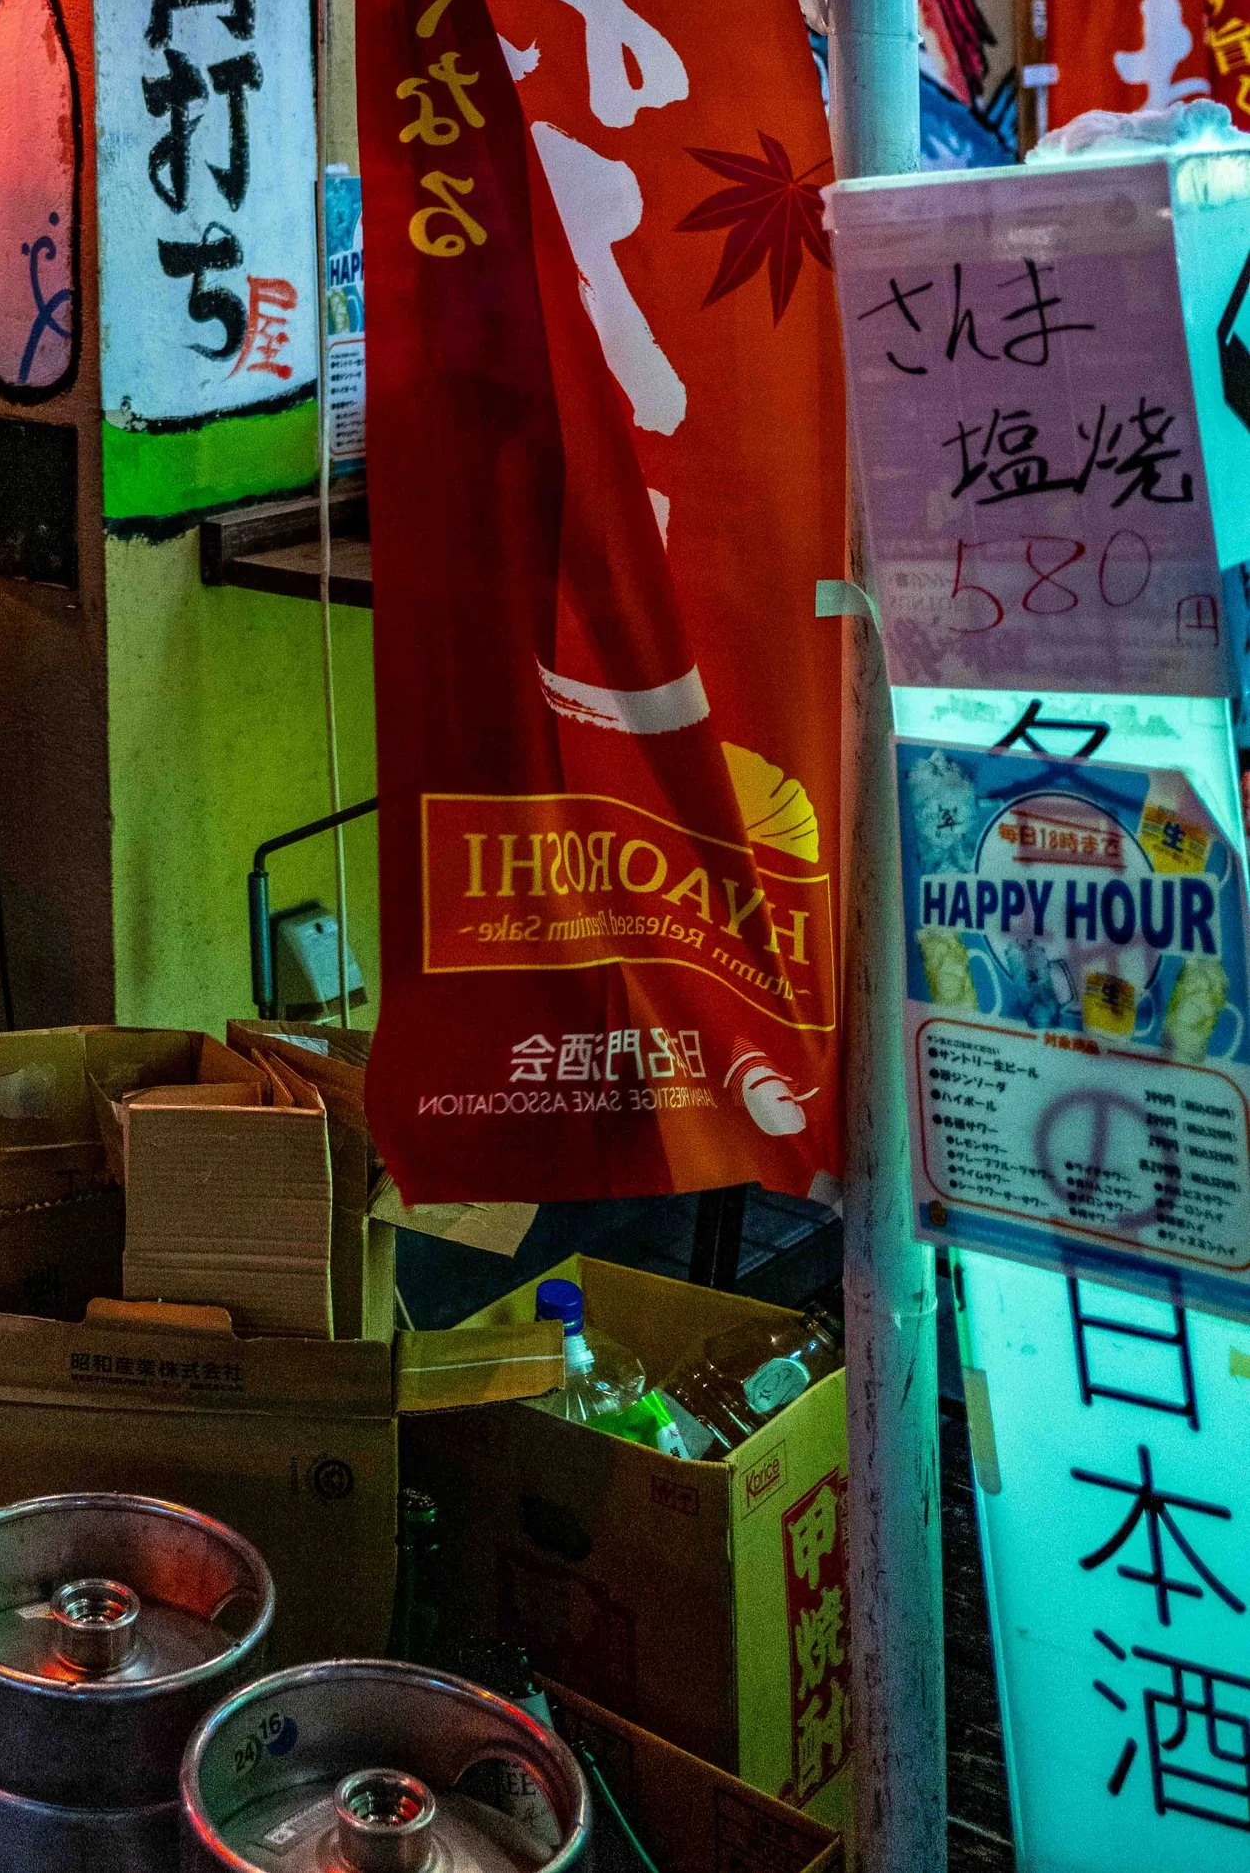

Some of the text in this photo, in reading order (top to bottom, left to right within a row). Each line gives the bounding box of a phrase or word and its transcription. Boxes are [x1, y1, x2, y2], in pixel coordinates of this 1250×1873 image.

[330, 250, 364, 287] HAP
[857, 259, 1095, 374] さんま
[942, 397, 1193, 507] 塩焼
[923, 878, 1218, 954] HAPPY HOUR
[70, 1352, 244, 1381] 昭和産業株式会社
